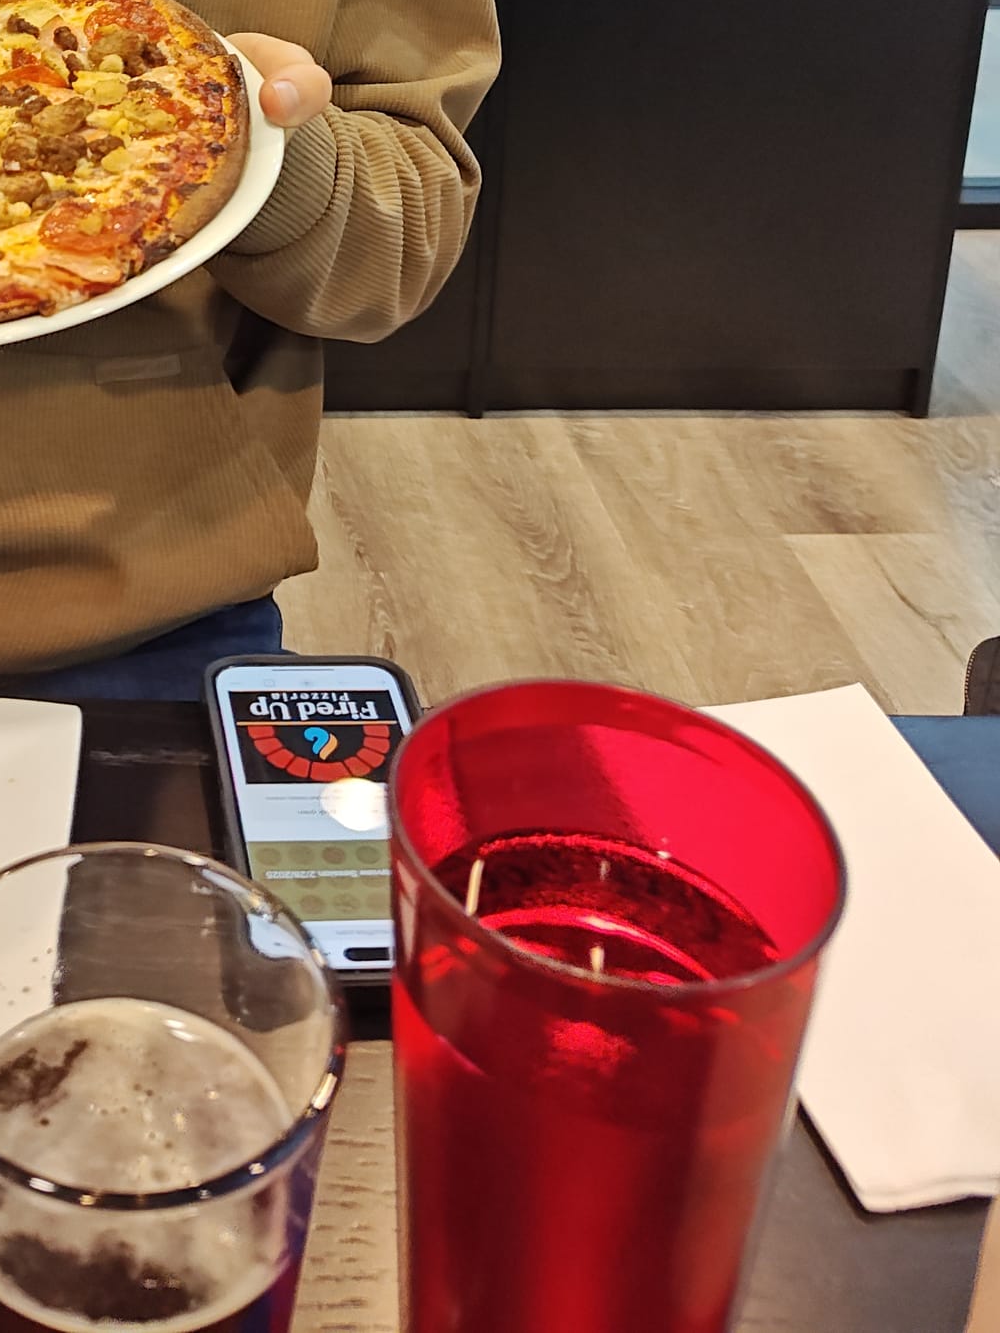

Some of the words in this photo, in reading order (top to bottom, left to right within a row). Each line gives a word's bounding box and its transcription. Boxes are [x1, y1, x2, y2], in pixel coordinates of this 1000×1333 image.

[271, 692, 350, 702] Pizzeria
[249, 696, 292, 720] Up
[296, 701, 379, 721] Fired
